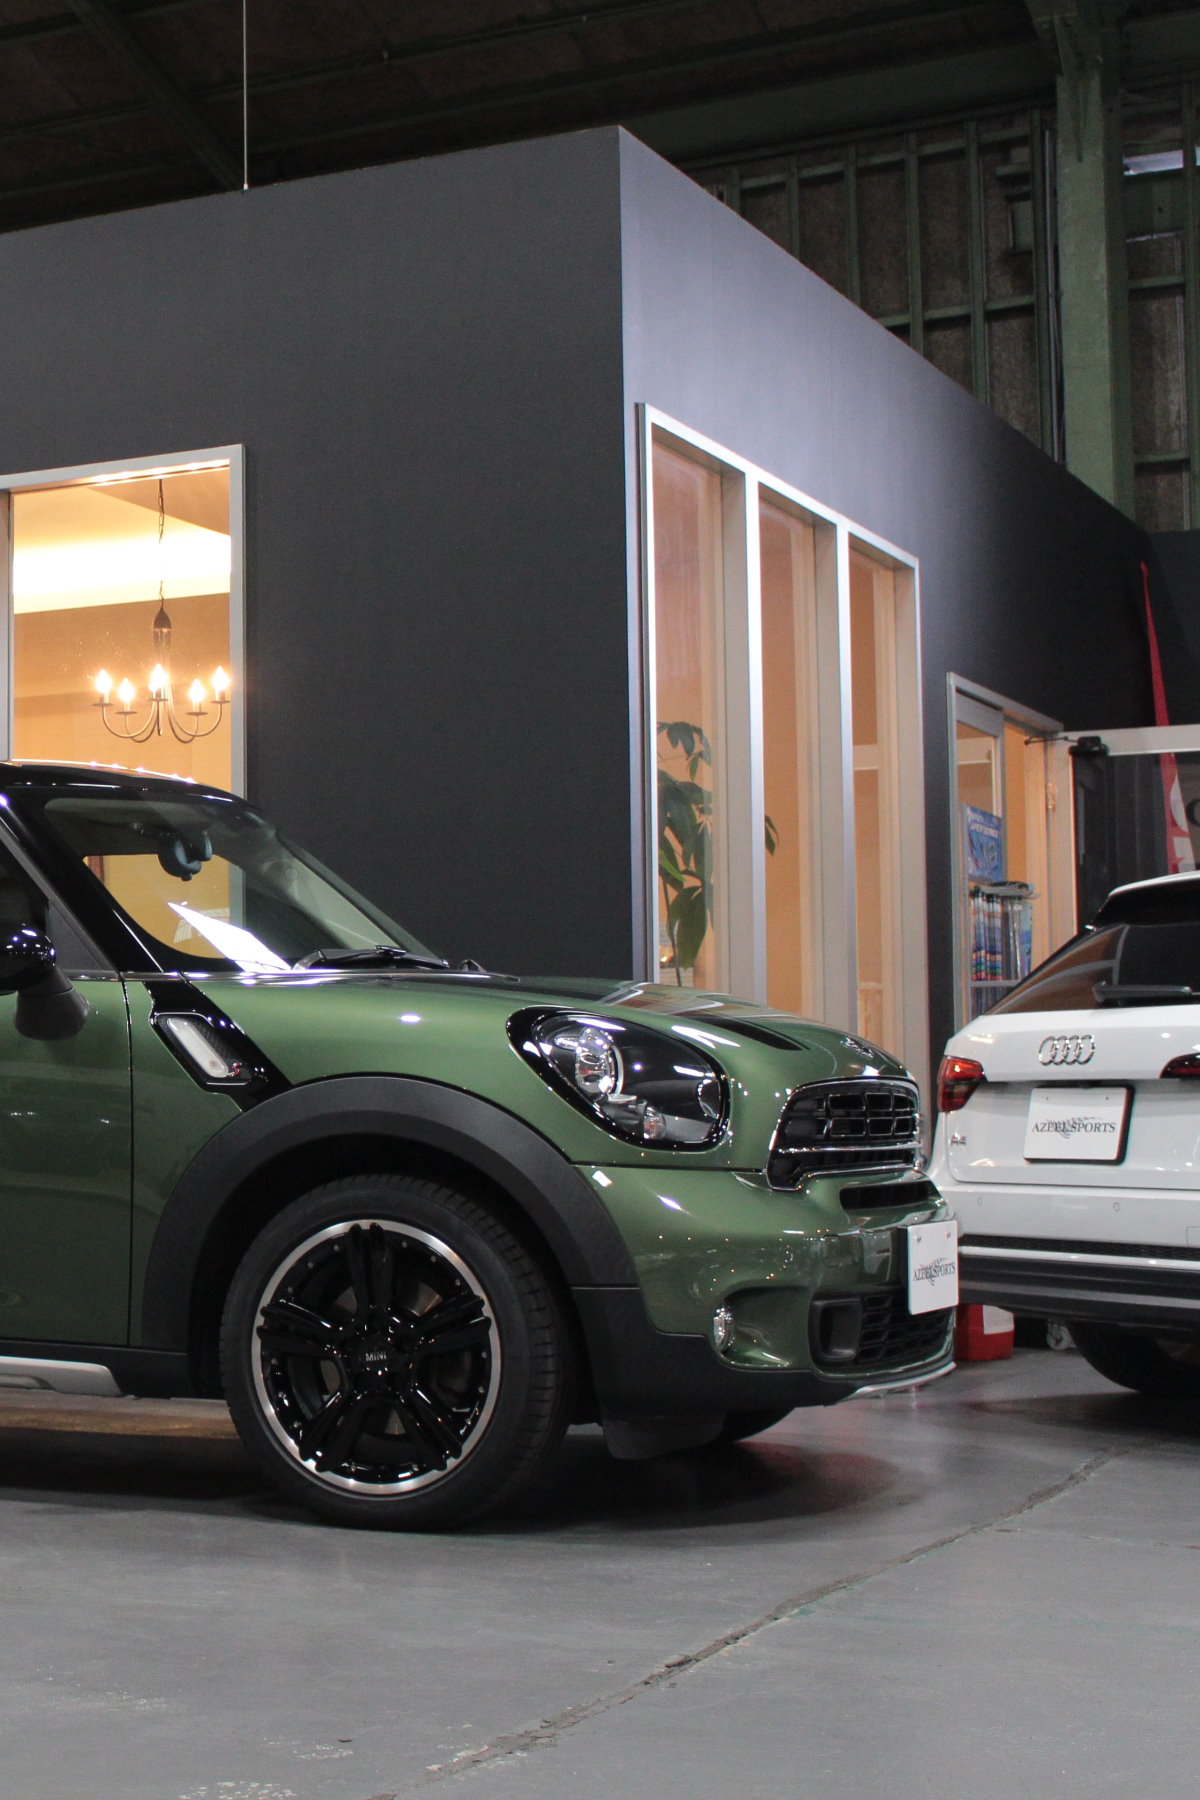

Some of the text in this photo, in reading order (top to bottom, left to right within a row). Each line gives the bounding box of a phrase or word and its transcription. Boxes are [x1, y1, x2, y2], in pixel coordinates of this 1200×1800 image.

[1071, 1121, 1116, 1133] SPORTS
[933, 1262, 956, 1279] SPORTS
[365, 1352, 387, 1362] MINI
